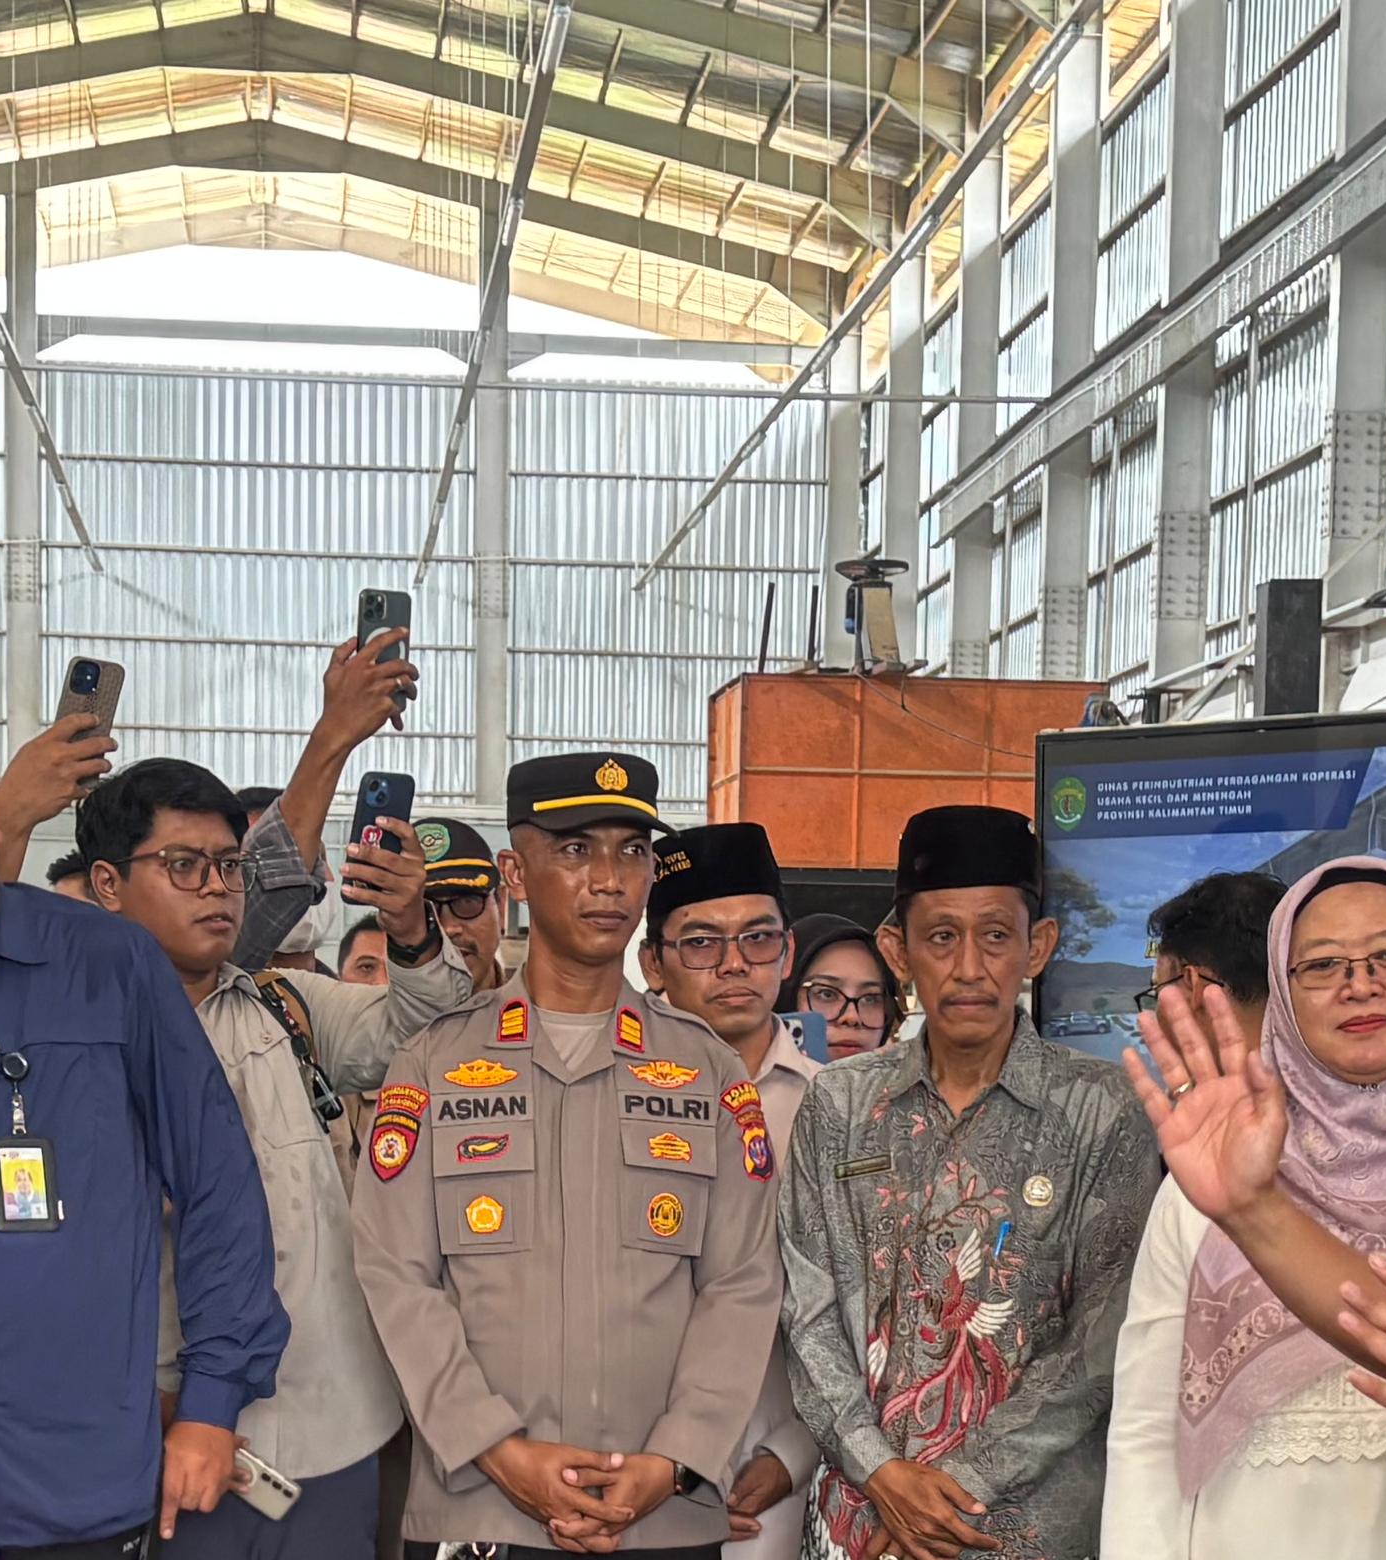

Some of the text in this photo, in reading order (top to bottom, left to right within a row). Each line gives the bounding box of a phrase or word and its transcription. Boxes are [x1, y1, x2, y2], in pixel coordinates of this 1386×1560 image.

[1098, 770, 1356, 792] DINAS PERINDUSTRIAN PERDAGANGAN KOPERASI
[1097, 790, 1251, 806] USAHA KECIL DAN MENENGAH
[1097, 805, 1252, 820] PROVINSI KALIMANTAN TIMUR
[439, 1095, 527, 1121] ASNAN
[625, 1095, 709, 1120] POLRI
